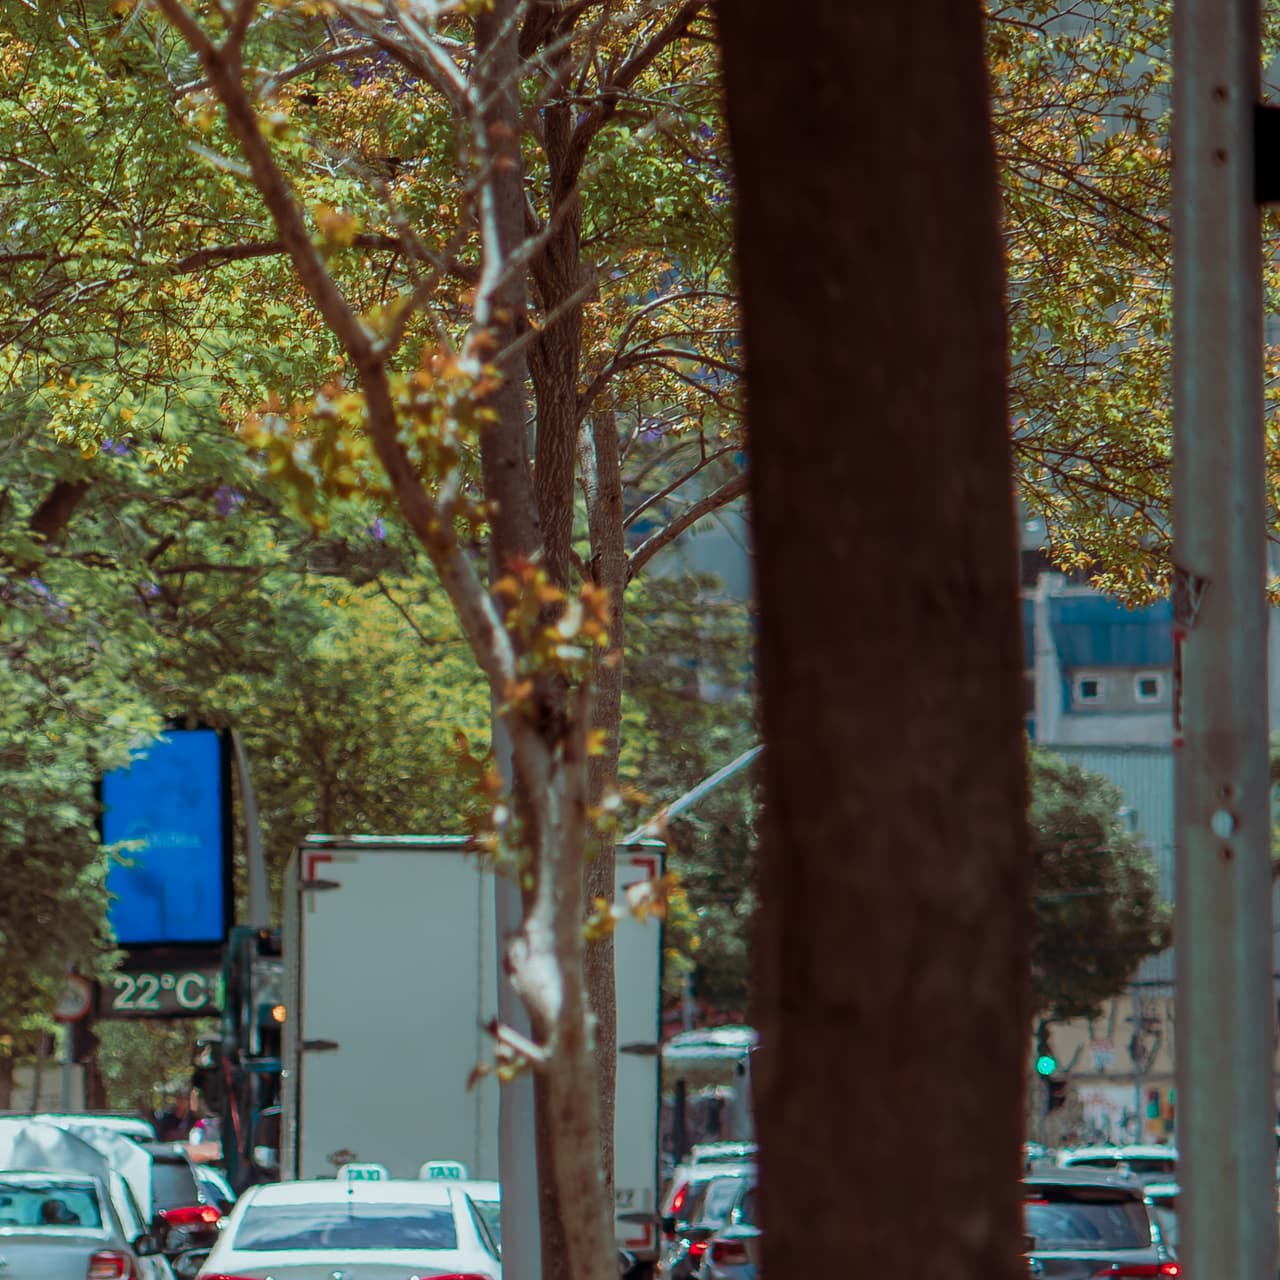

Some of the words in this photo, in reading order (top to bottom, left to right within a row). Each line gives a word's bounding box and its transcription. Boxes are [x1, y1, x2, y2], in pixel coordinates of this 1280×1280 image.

[113, 972, 208, 1010] 22°C
[347, 1169, 381, 1182] TAXI
[429, 1166, 460, 1179] TAXI
